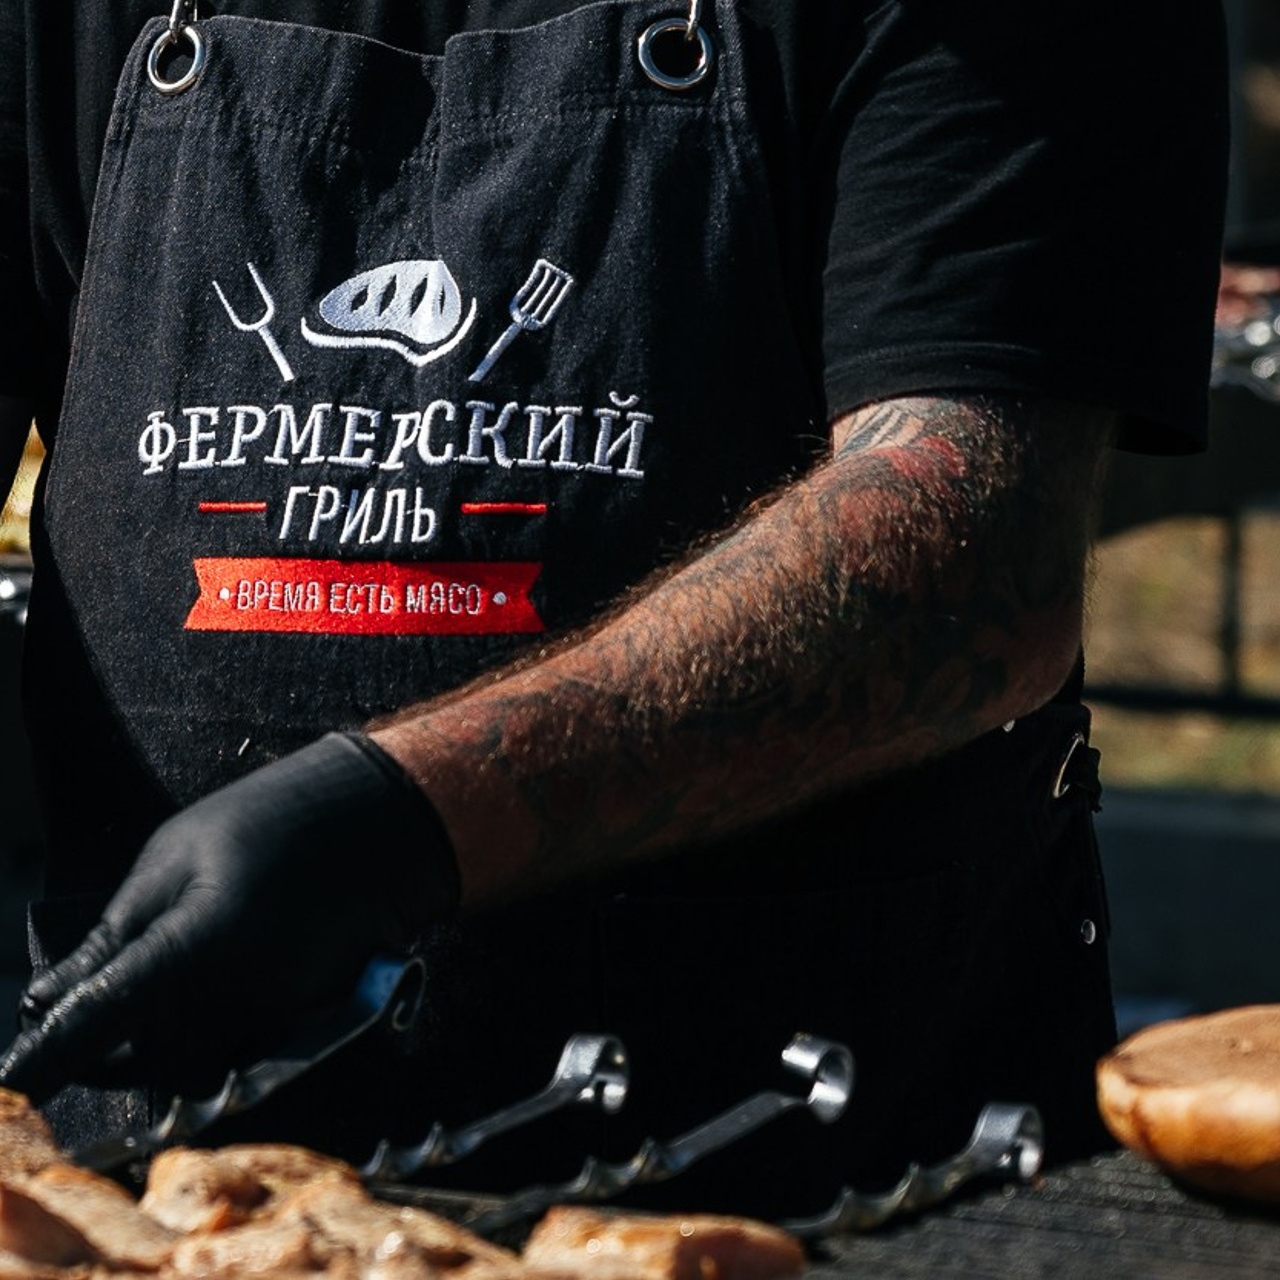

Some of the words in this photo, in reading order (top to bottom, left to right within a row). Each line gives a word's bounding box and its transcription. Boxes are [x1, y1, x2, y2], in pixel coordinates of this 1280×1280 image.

[138, 392, 653, 478] ФЕРМЕРСКИЙ
[279, 486, 437, 544] ГРИЛЬ
[236, 580, 320, 611] ВРЕМЯ
[329, 582, 395, 614] ЕСТЬ
[406, 583, 481, 615] МЯСО
